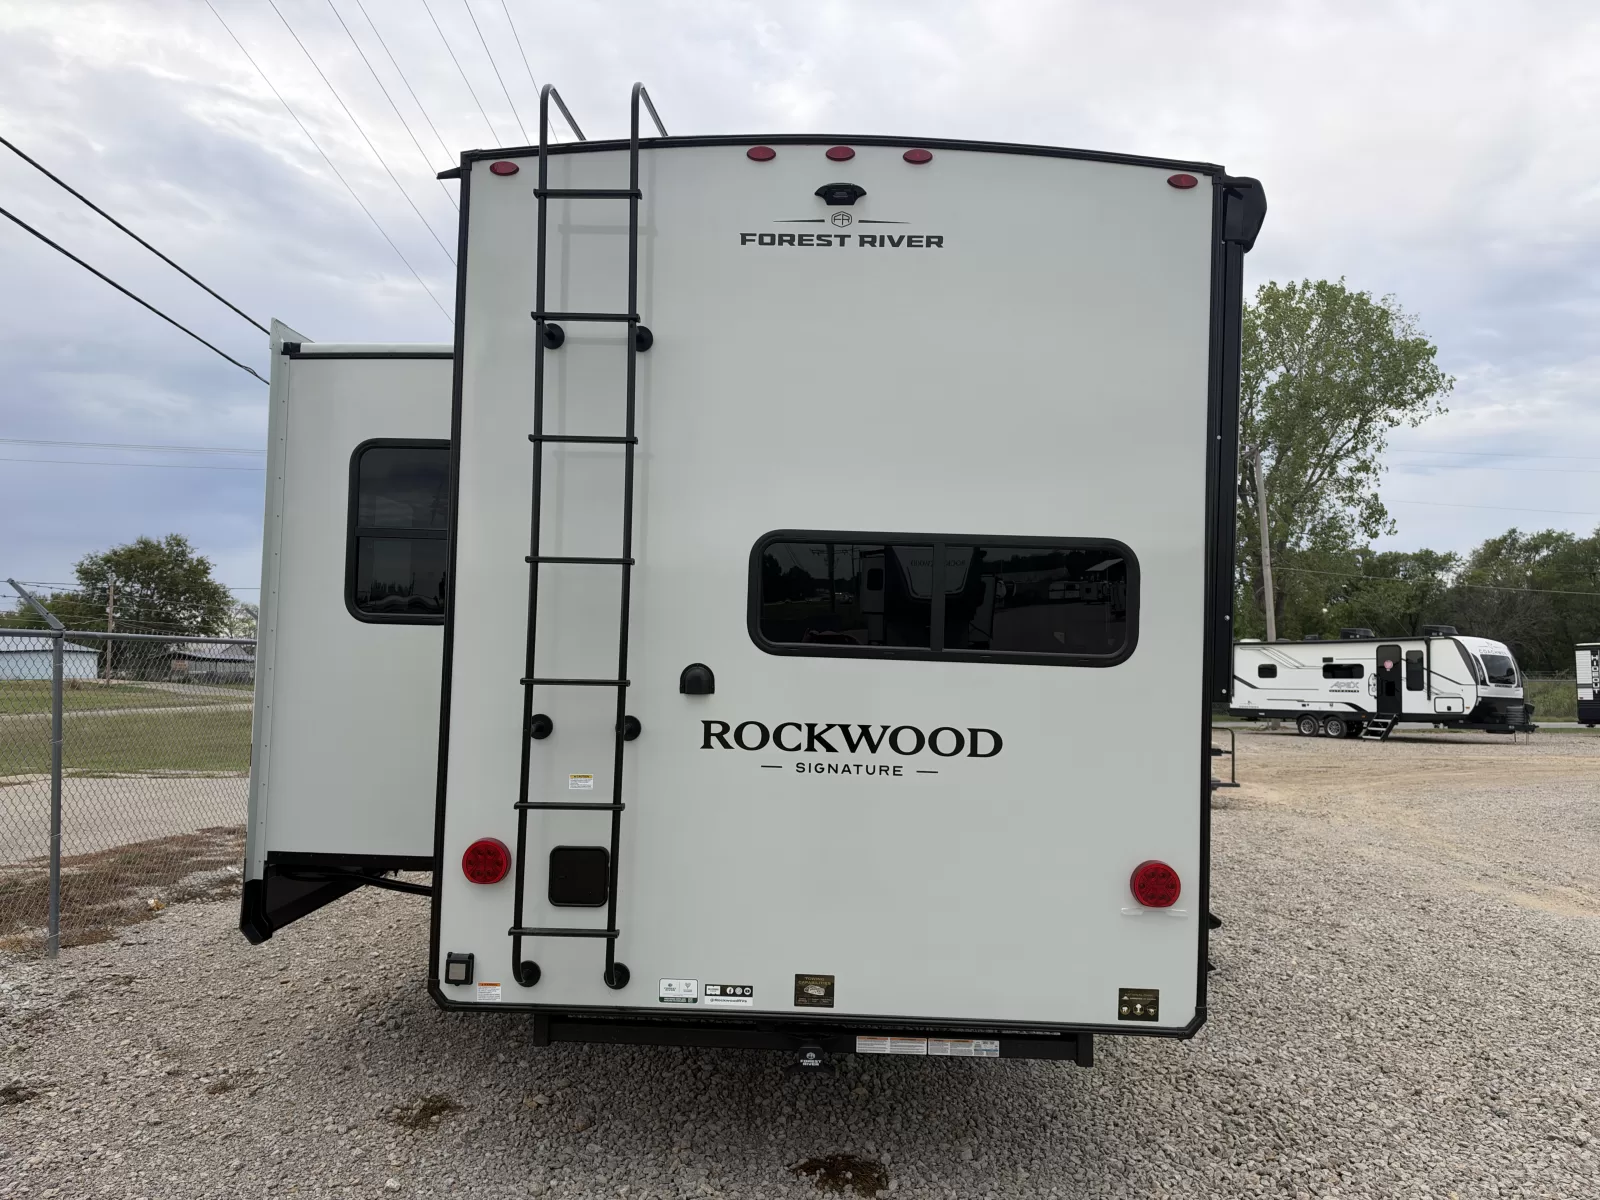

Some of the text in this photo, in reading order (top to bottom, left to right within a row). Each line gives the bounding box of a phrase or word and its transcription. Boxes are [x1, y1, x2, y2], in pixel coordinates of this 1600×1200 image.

[739, 232, 944, 249] FOREST RIVER
[699, 719, 1003, 758] ROCKWOOD
[795, 761, 904, 777] SIGNATURE
